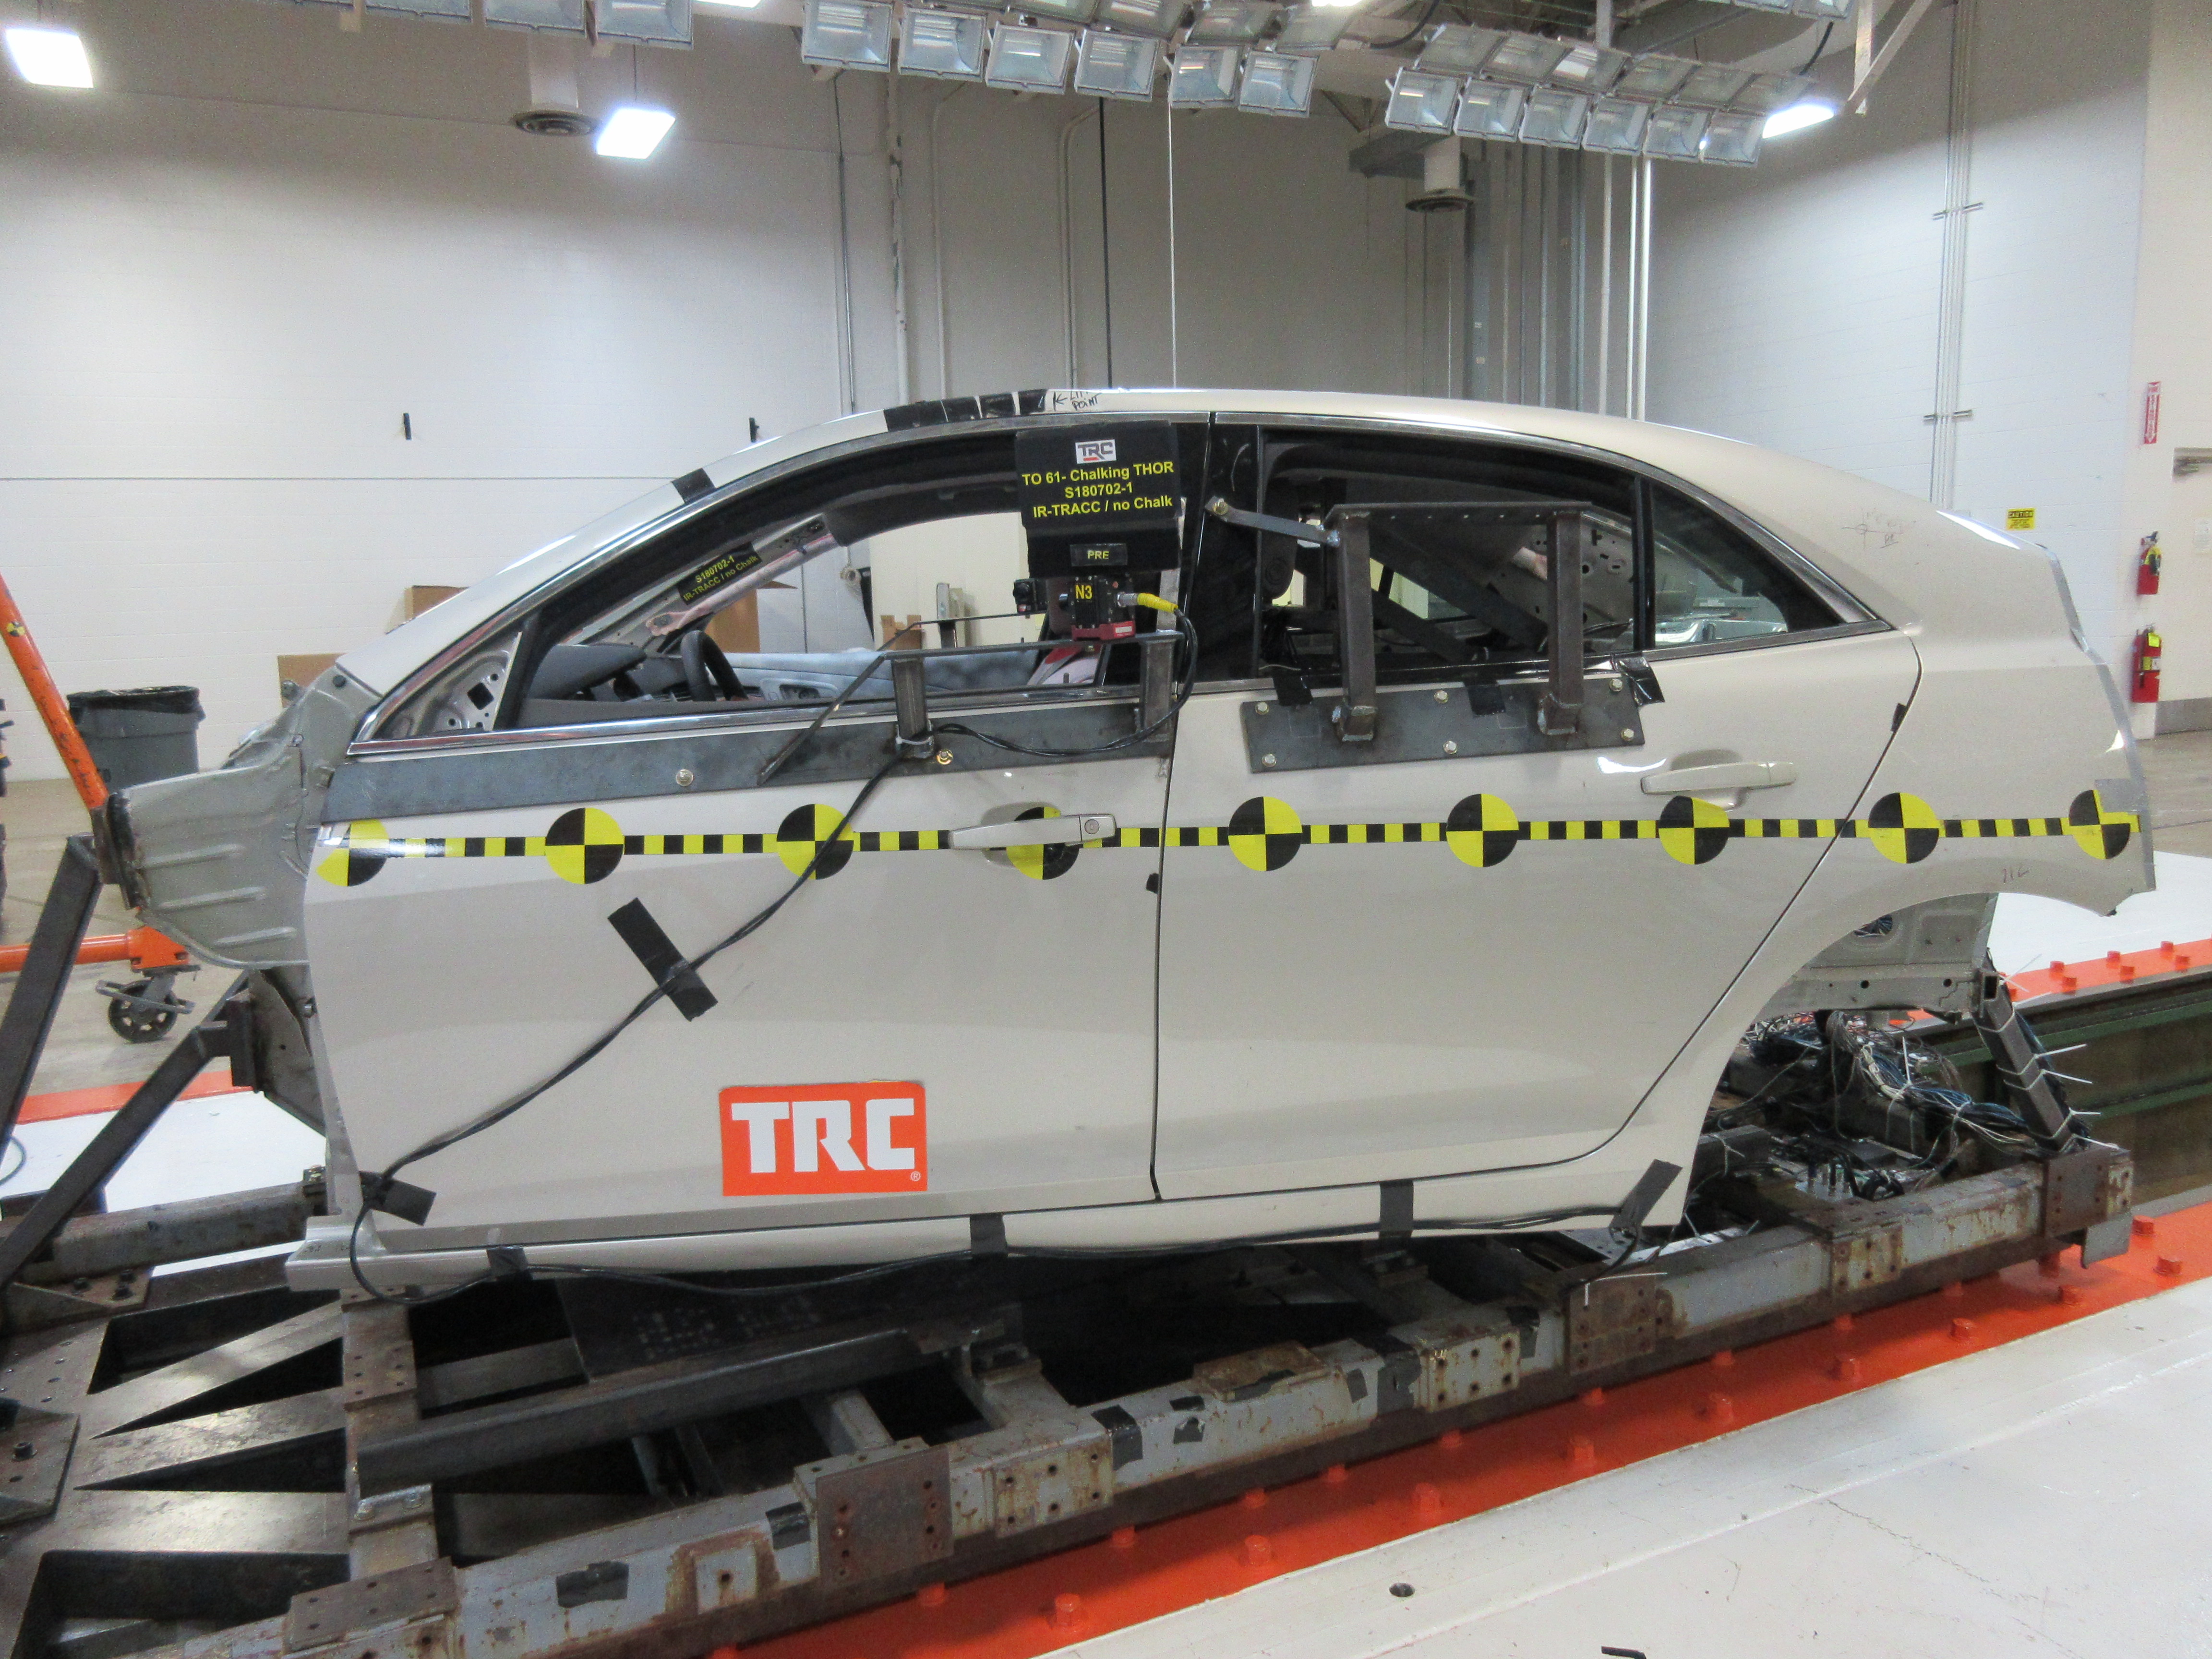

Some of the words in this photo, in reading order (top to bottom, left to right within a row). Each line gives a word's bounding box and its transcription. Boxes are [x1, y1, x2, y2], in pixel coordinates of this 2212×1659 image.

[1077, 442, 1113, 460] TRC
[1022, 473, 1042, 486] TO
[1046, 471, 1067, 484] 61-
[1070, 466, 1130, 482] Chalking
[1132, 461, 1174, 476] THOR
[1064, 481, 1133, 499] S180702-1
[1033, 501, 1101, 518] IR-TRACC
[1105, 500, 1109, 512] /
[1113, 501, 1130, 511] no
[1134, 495, 1173, 509] Chalk
[1087, 550, 1109, 560] PRE
[683, 577, 721, 601] IR-TRACC
[725, 569, 736, 578] no
[736, 555, 759, 570] Chalk
[695, 555, 735, 583] S180702-1
[1075, 584, 1093, 600] N3
[731, 1098, 915, 1173] TRC
